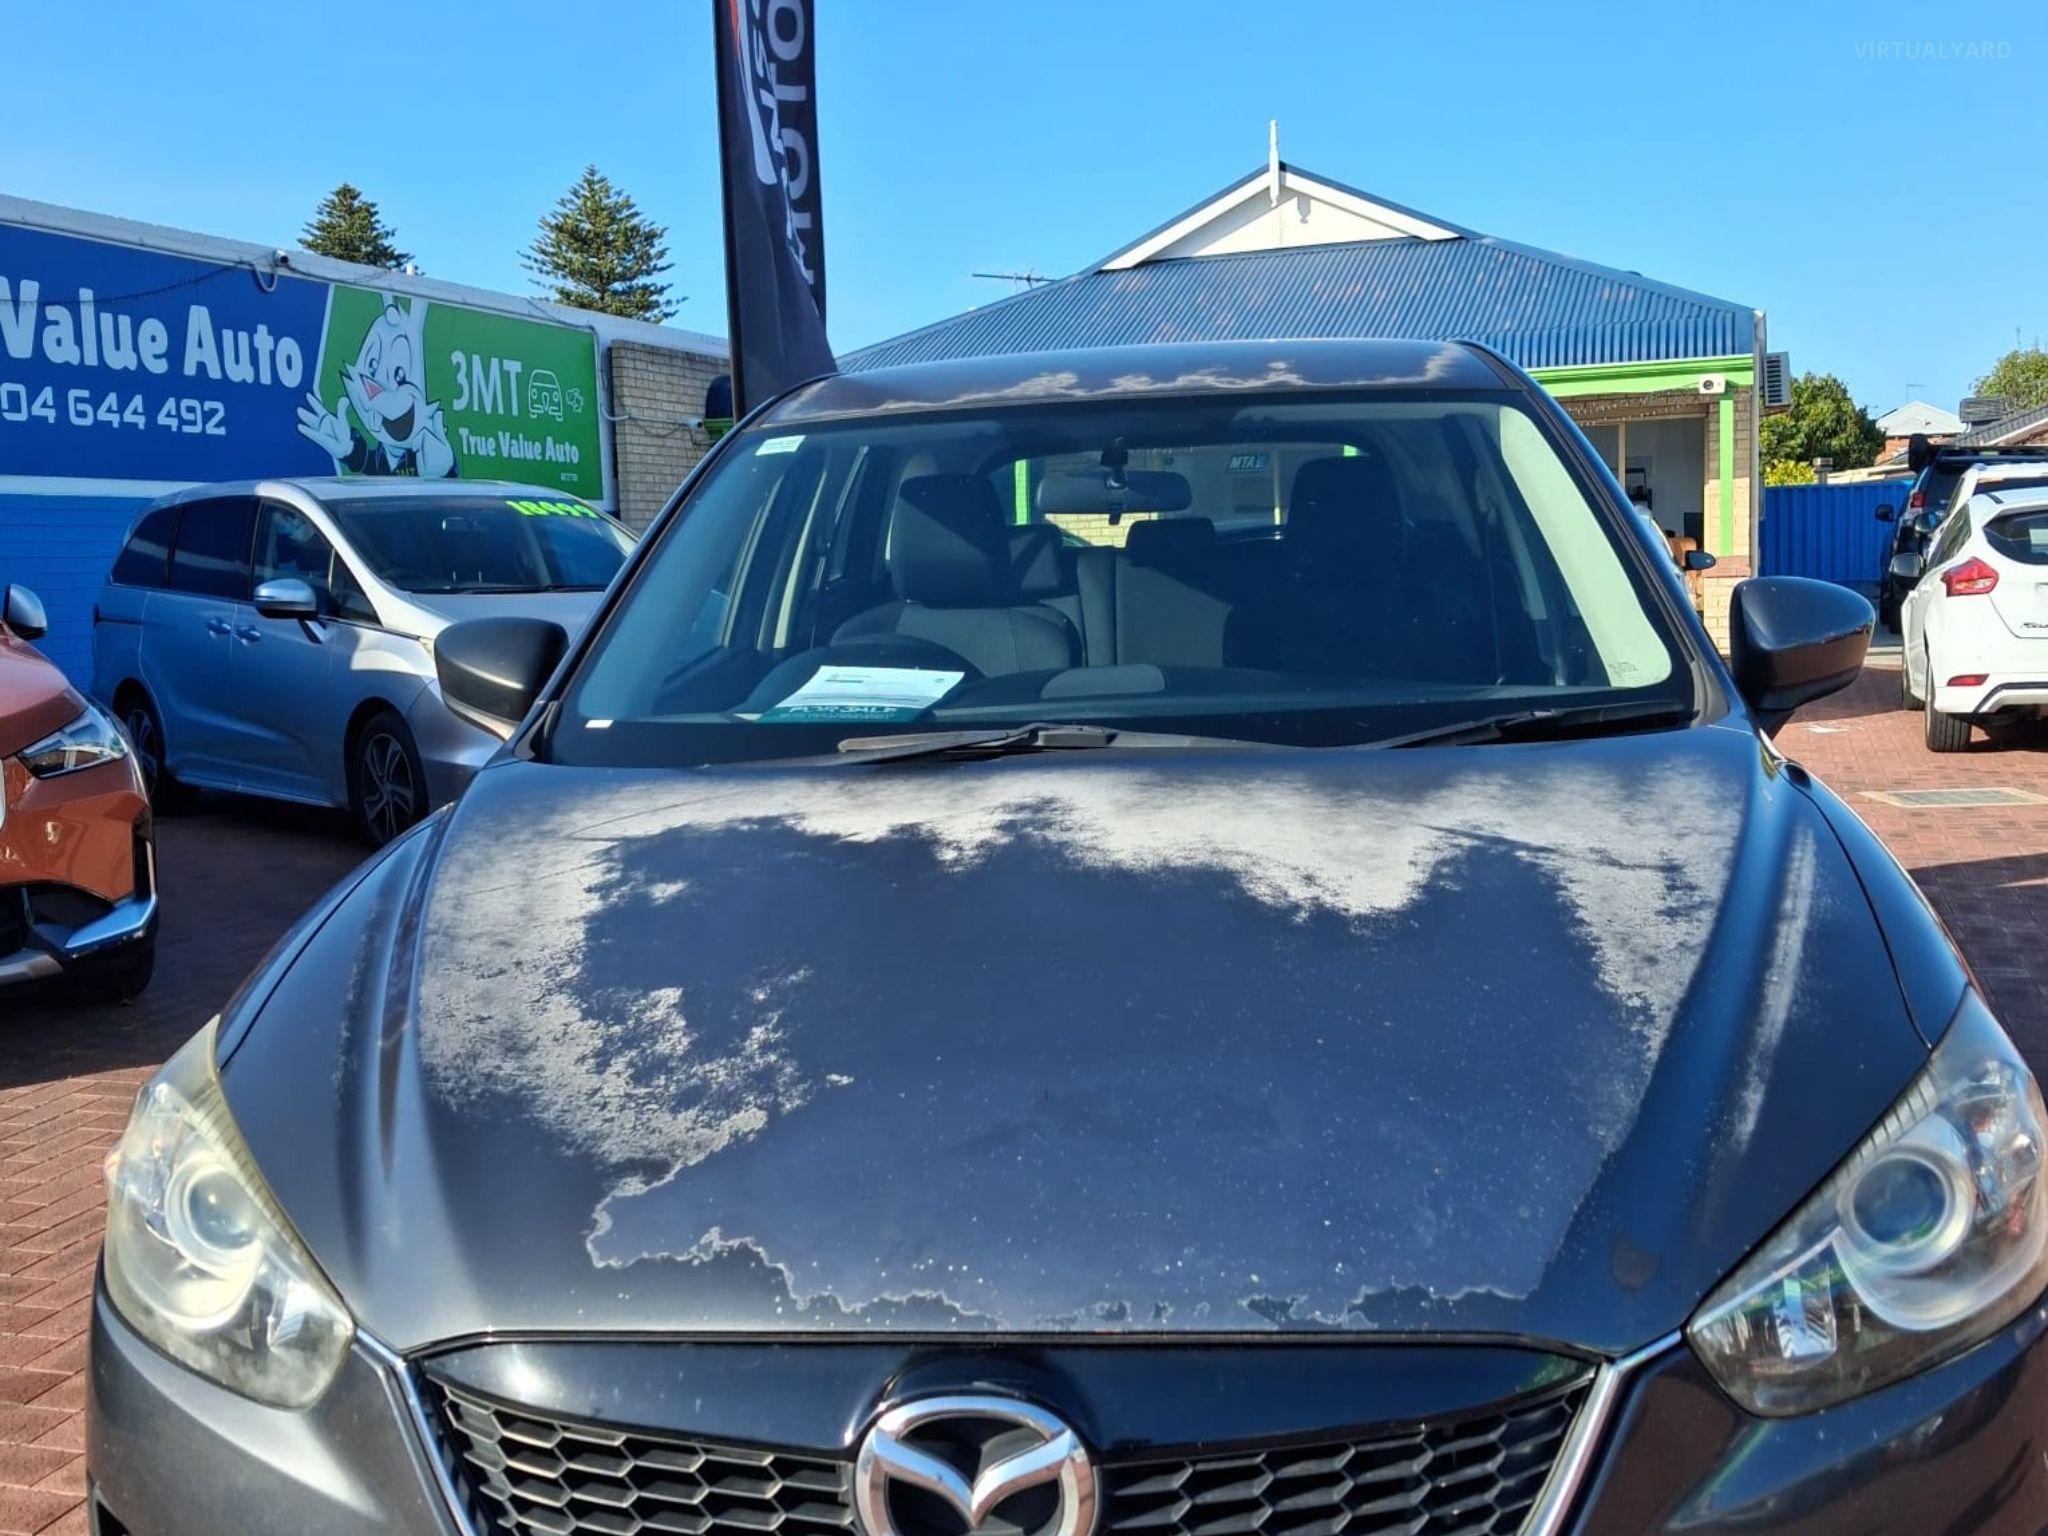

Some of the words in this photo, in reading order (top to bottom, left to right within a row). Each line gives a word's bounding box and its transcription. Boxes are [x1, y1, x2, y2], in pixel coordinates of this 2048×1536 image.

[0, 275, 169, 375] Value
[183, 305, 304, 388] Auto
[451, 350, 522, 416] 3MT
[68, 388, 146, 430] 644
[157, 397, 226, 436] 492
[458, 427, 496, 457] True
[498, 431, 543, 461] Value
[545, 436, 579, 464] Auto
